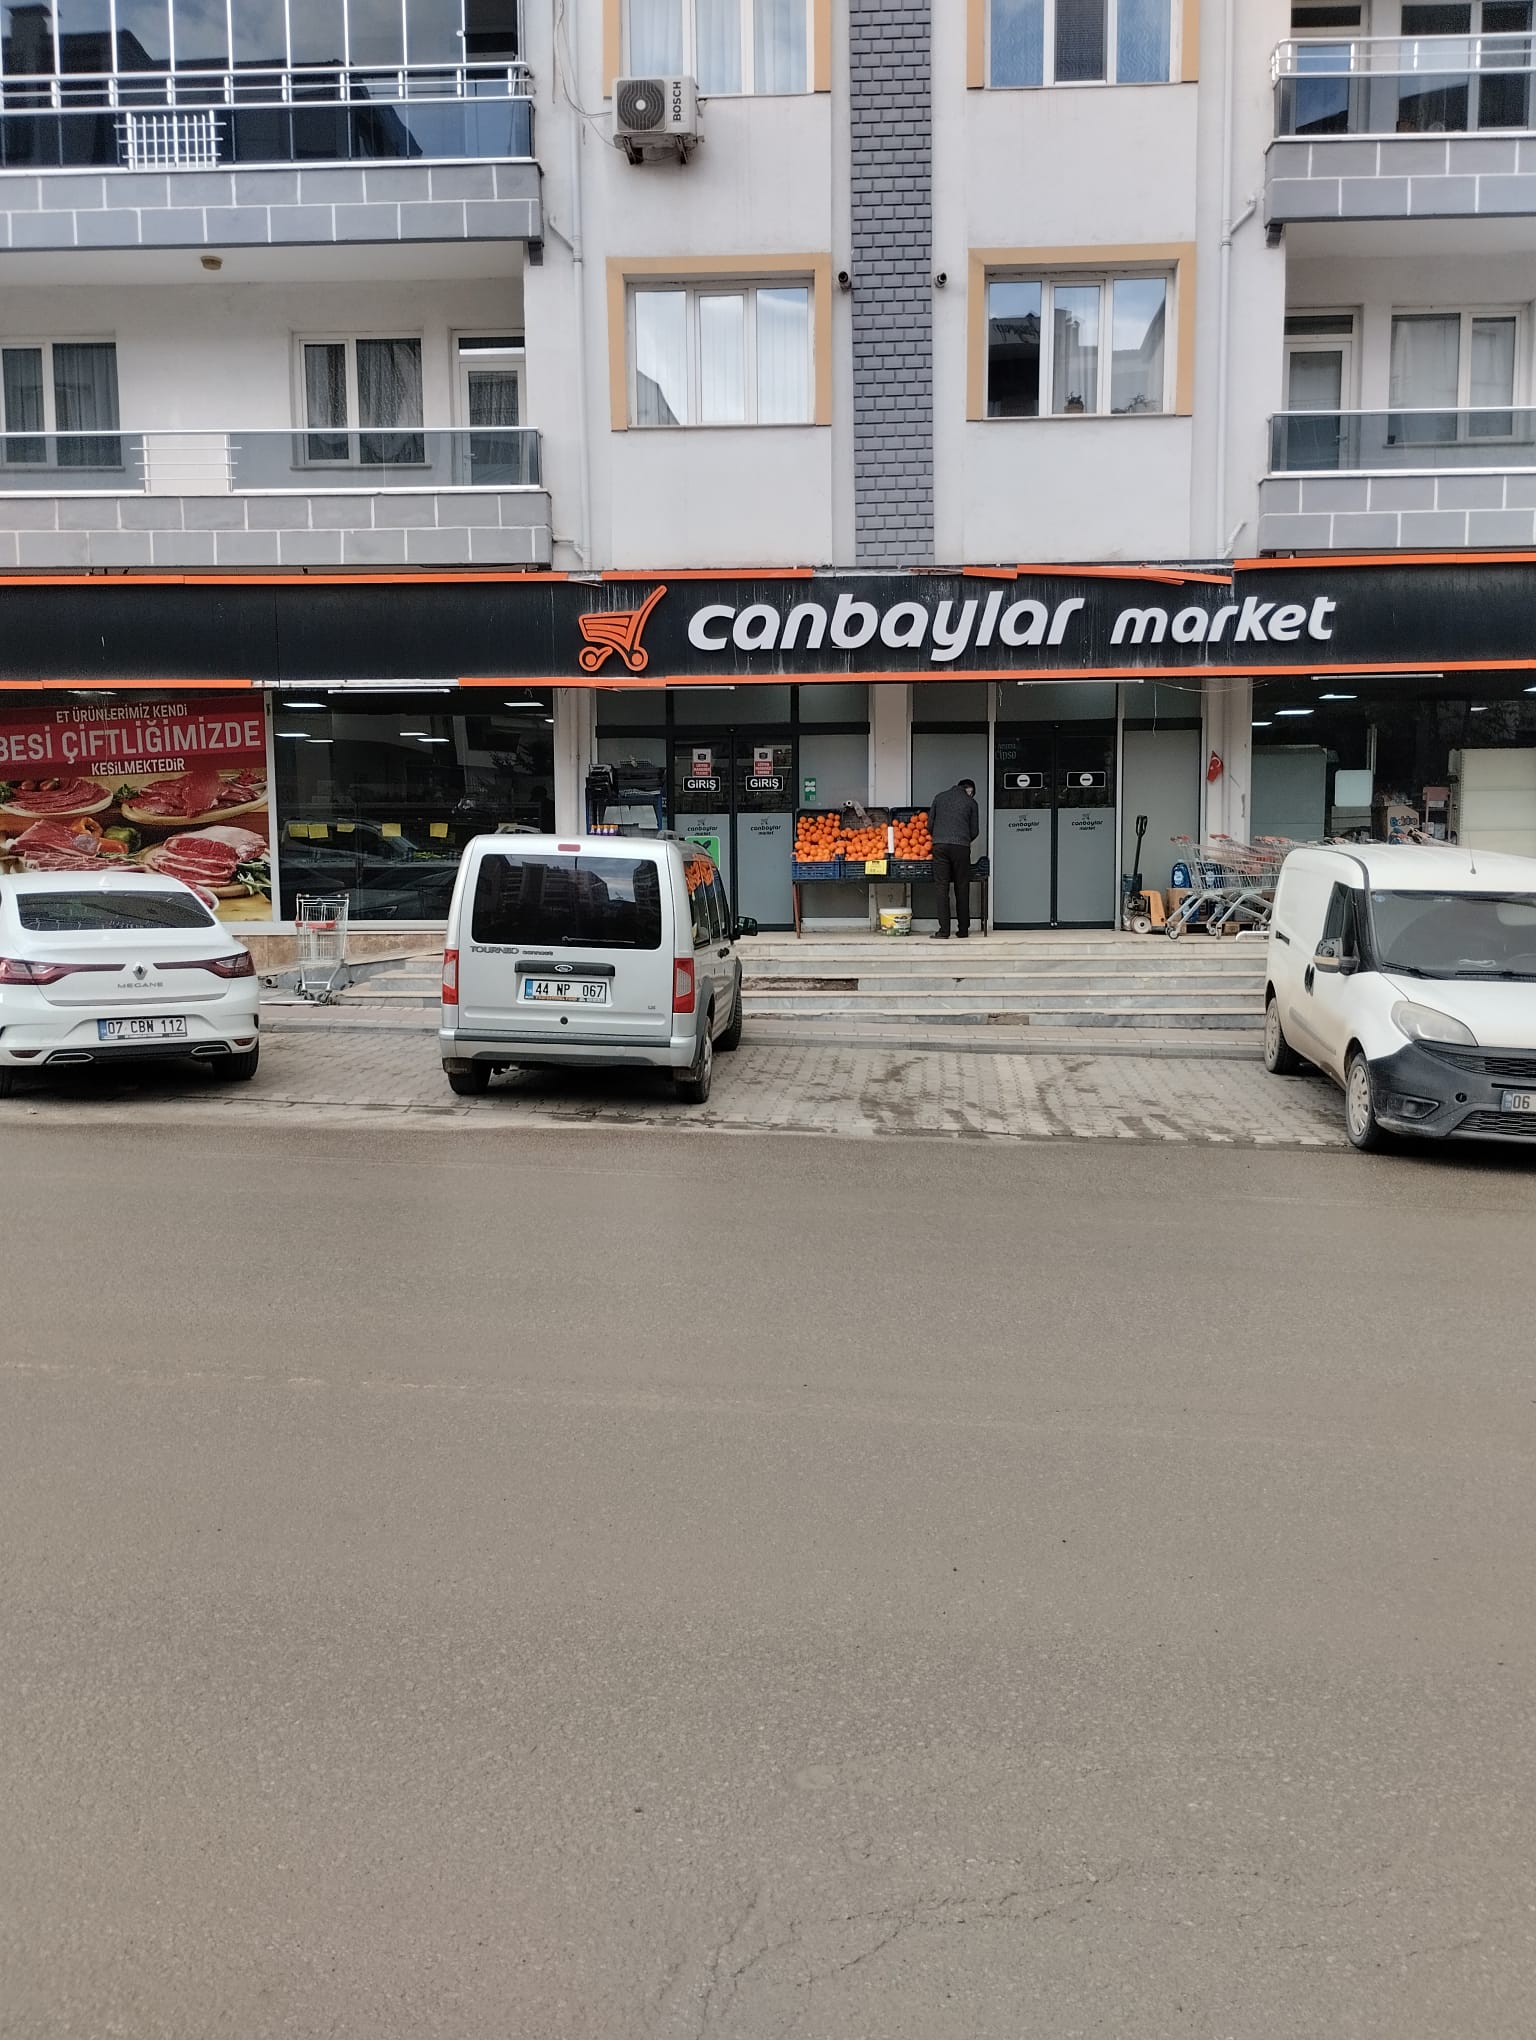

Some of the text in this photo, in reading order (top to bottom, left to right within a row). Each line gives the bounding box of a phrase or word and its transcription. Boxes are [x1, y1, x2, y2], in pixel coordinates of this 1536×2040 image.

[672, 81, 681, 121] BOSCH
[687, 590, 1337, 662] canbaylar market
[56, 711, 69, 723] ET
[61, 716, 261, 764] ÇİFTLİĞİMİZDE
[470, 946, 519, 955] TOURNEO
[535, 983, 549, 995] 44
[556, 983, 571, 996] NP
[582, 985, 604, 998] 067
[108, 1019, 184, 1034] 07 CBN 112
[1512, 1095, 1531, 1109] 06
